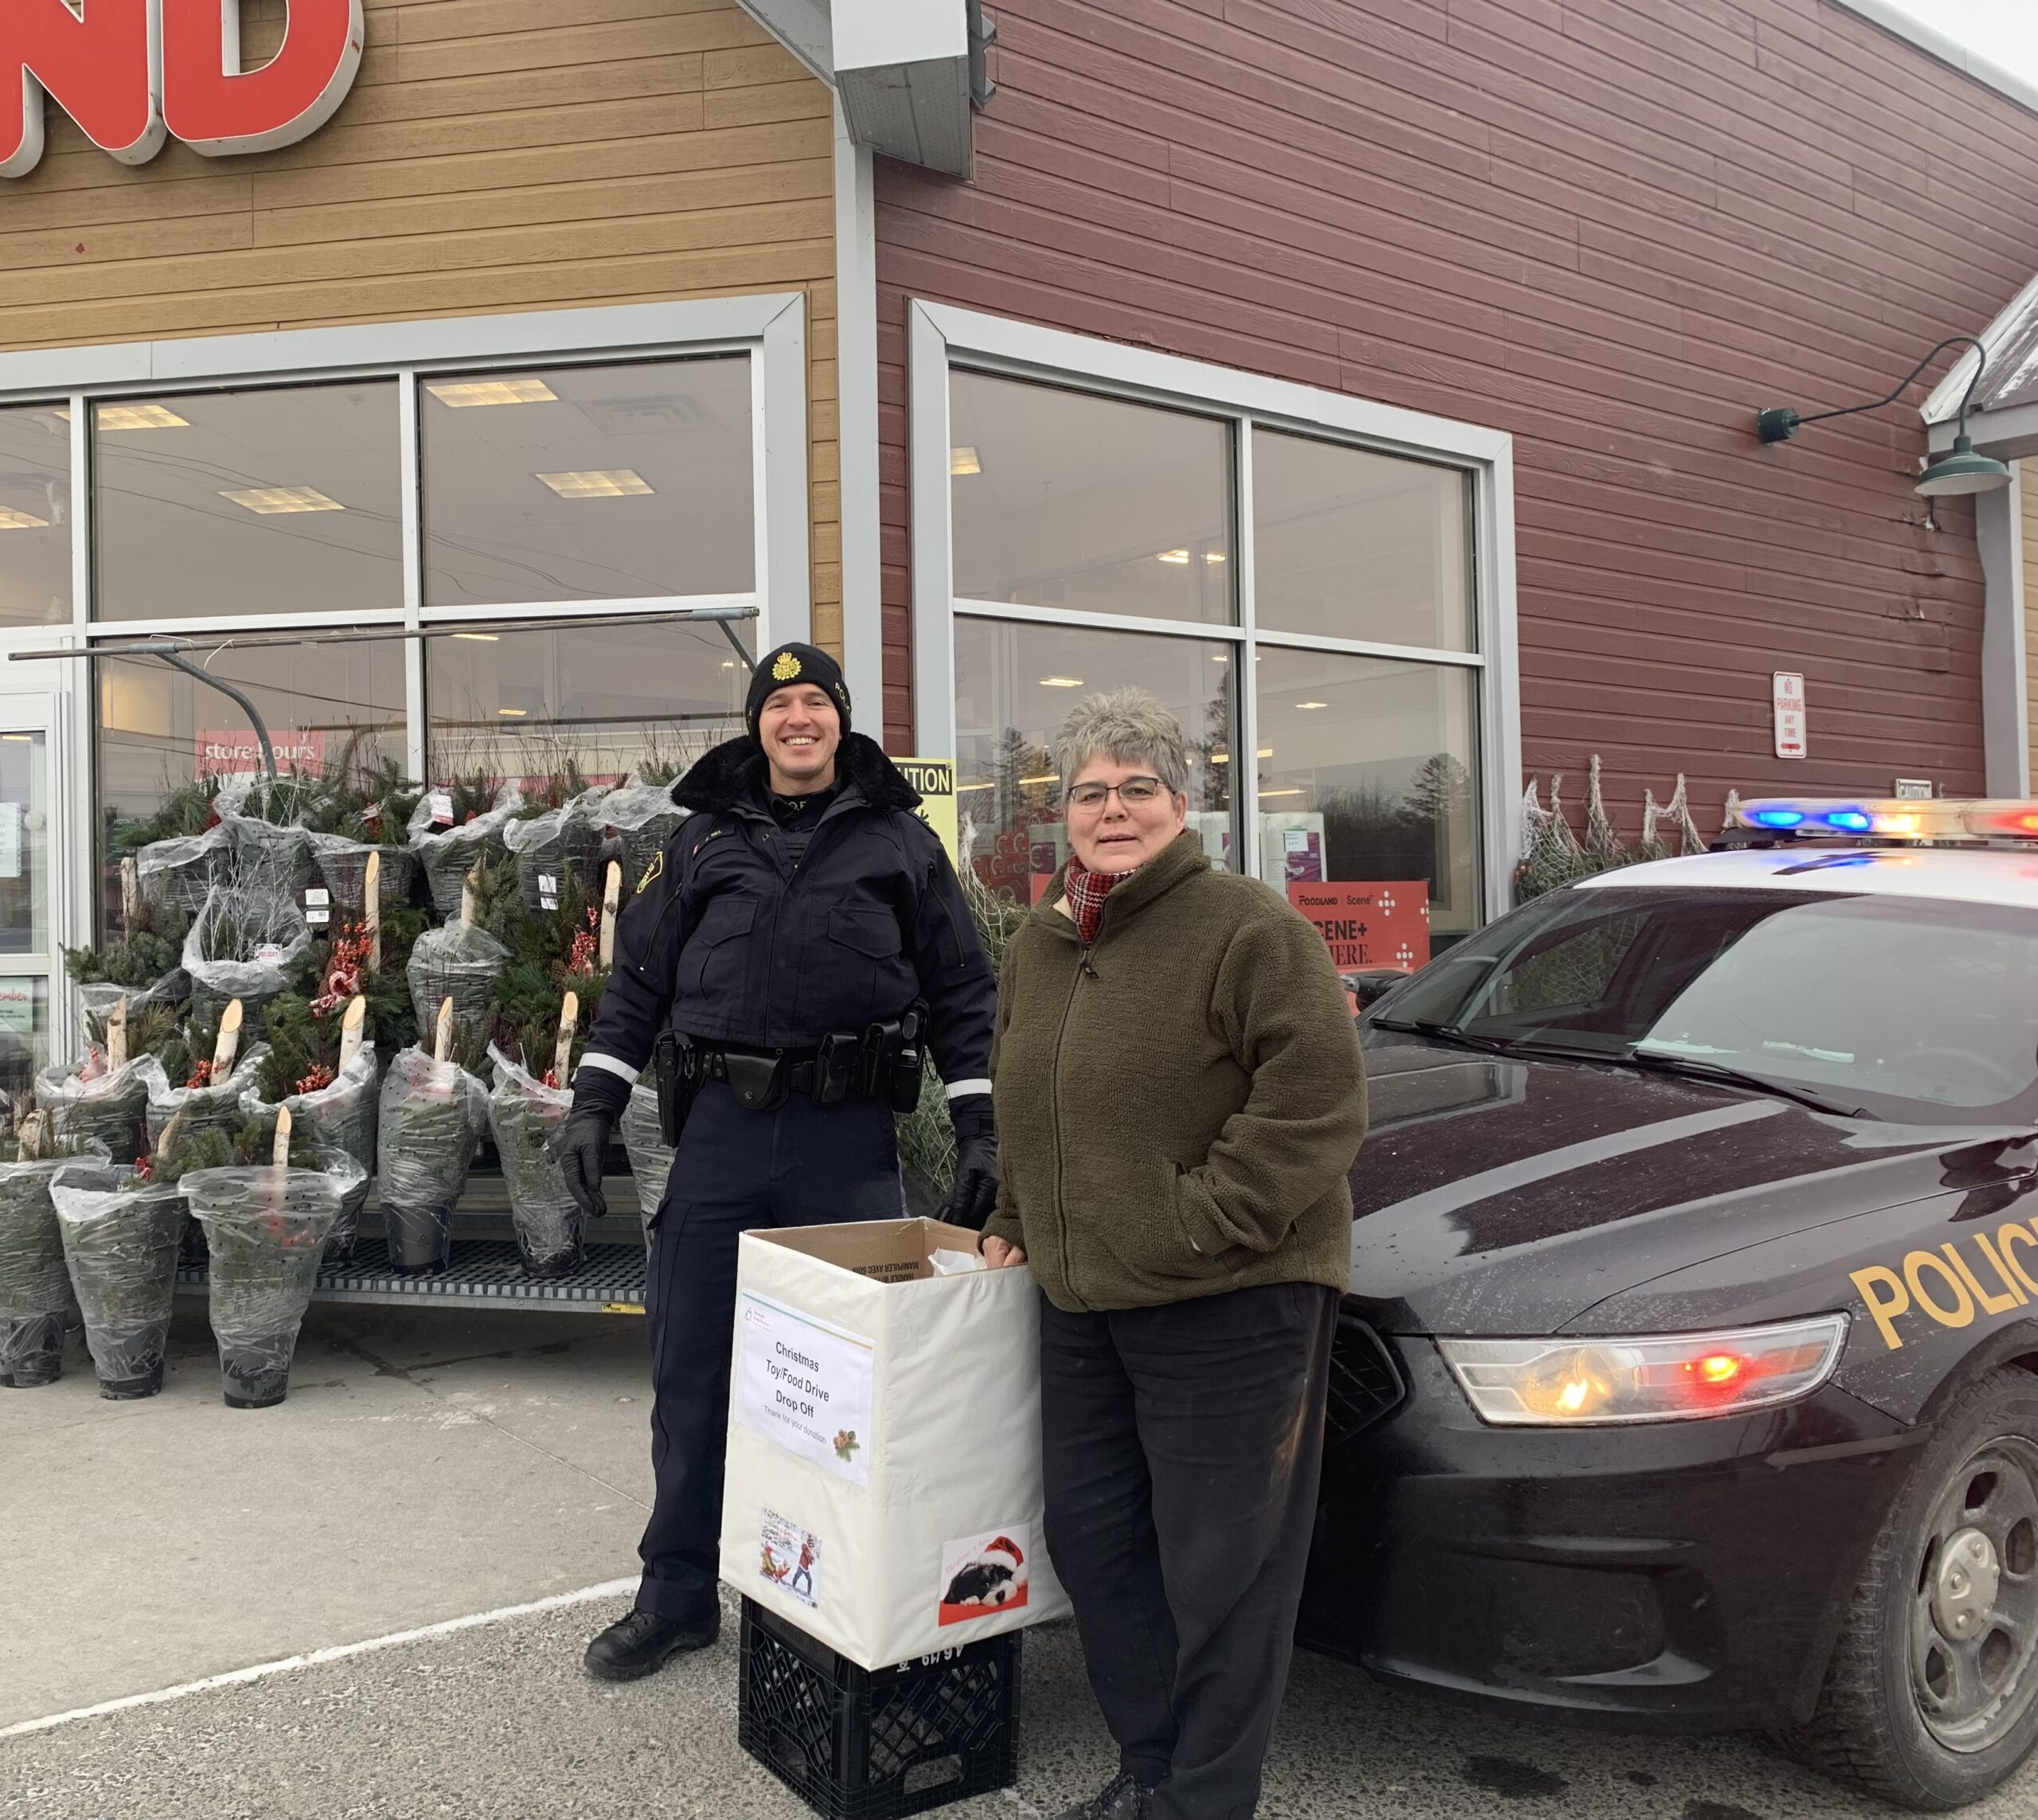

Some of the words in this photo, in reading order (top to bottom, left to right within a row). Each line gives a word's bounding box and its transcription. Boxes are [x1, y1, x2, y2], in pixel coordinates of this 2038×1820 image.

[1784, 682, 1792, 694] NO
[1777, 697, 1802, 712] PARKING
[1785, 715, 1794, 724] ANY
[1784, 728, 1797, 738] TIME
[205, 742, 252, 760] store
[1299, 895, 1337, 906] FOODLAND
[868, 1263, 884, 1274] AVEC
[884, 1261, 919, 1272] MANIPULER
[1849, 1217, 2038, 1350] POLIC
[775, 1342, 819, 1373] Christmas
[766, 1359, 803, 1389] Toy/Food
[805, 1380, 830, 1402] Drive
[776, 1389, 798, 1411] Drop
[800, 1401, 814, 1419] Off
[764, 1405, 782, 1420] Thank
[791, 1419, 802, 1431] your
[803, 1424, 827, 1444] donation
